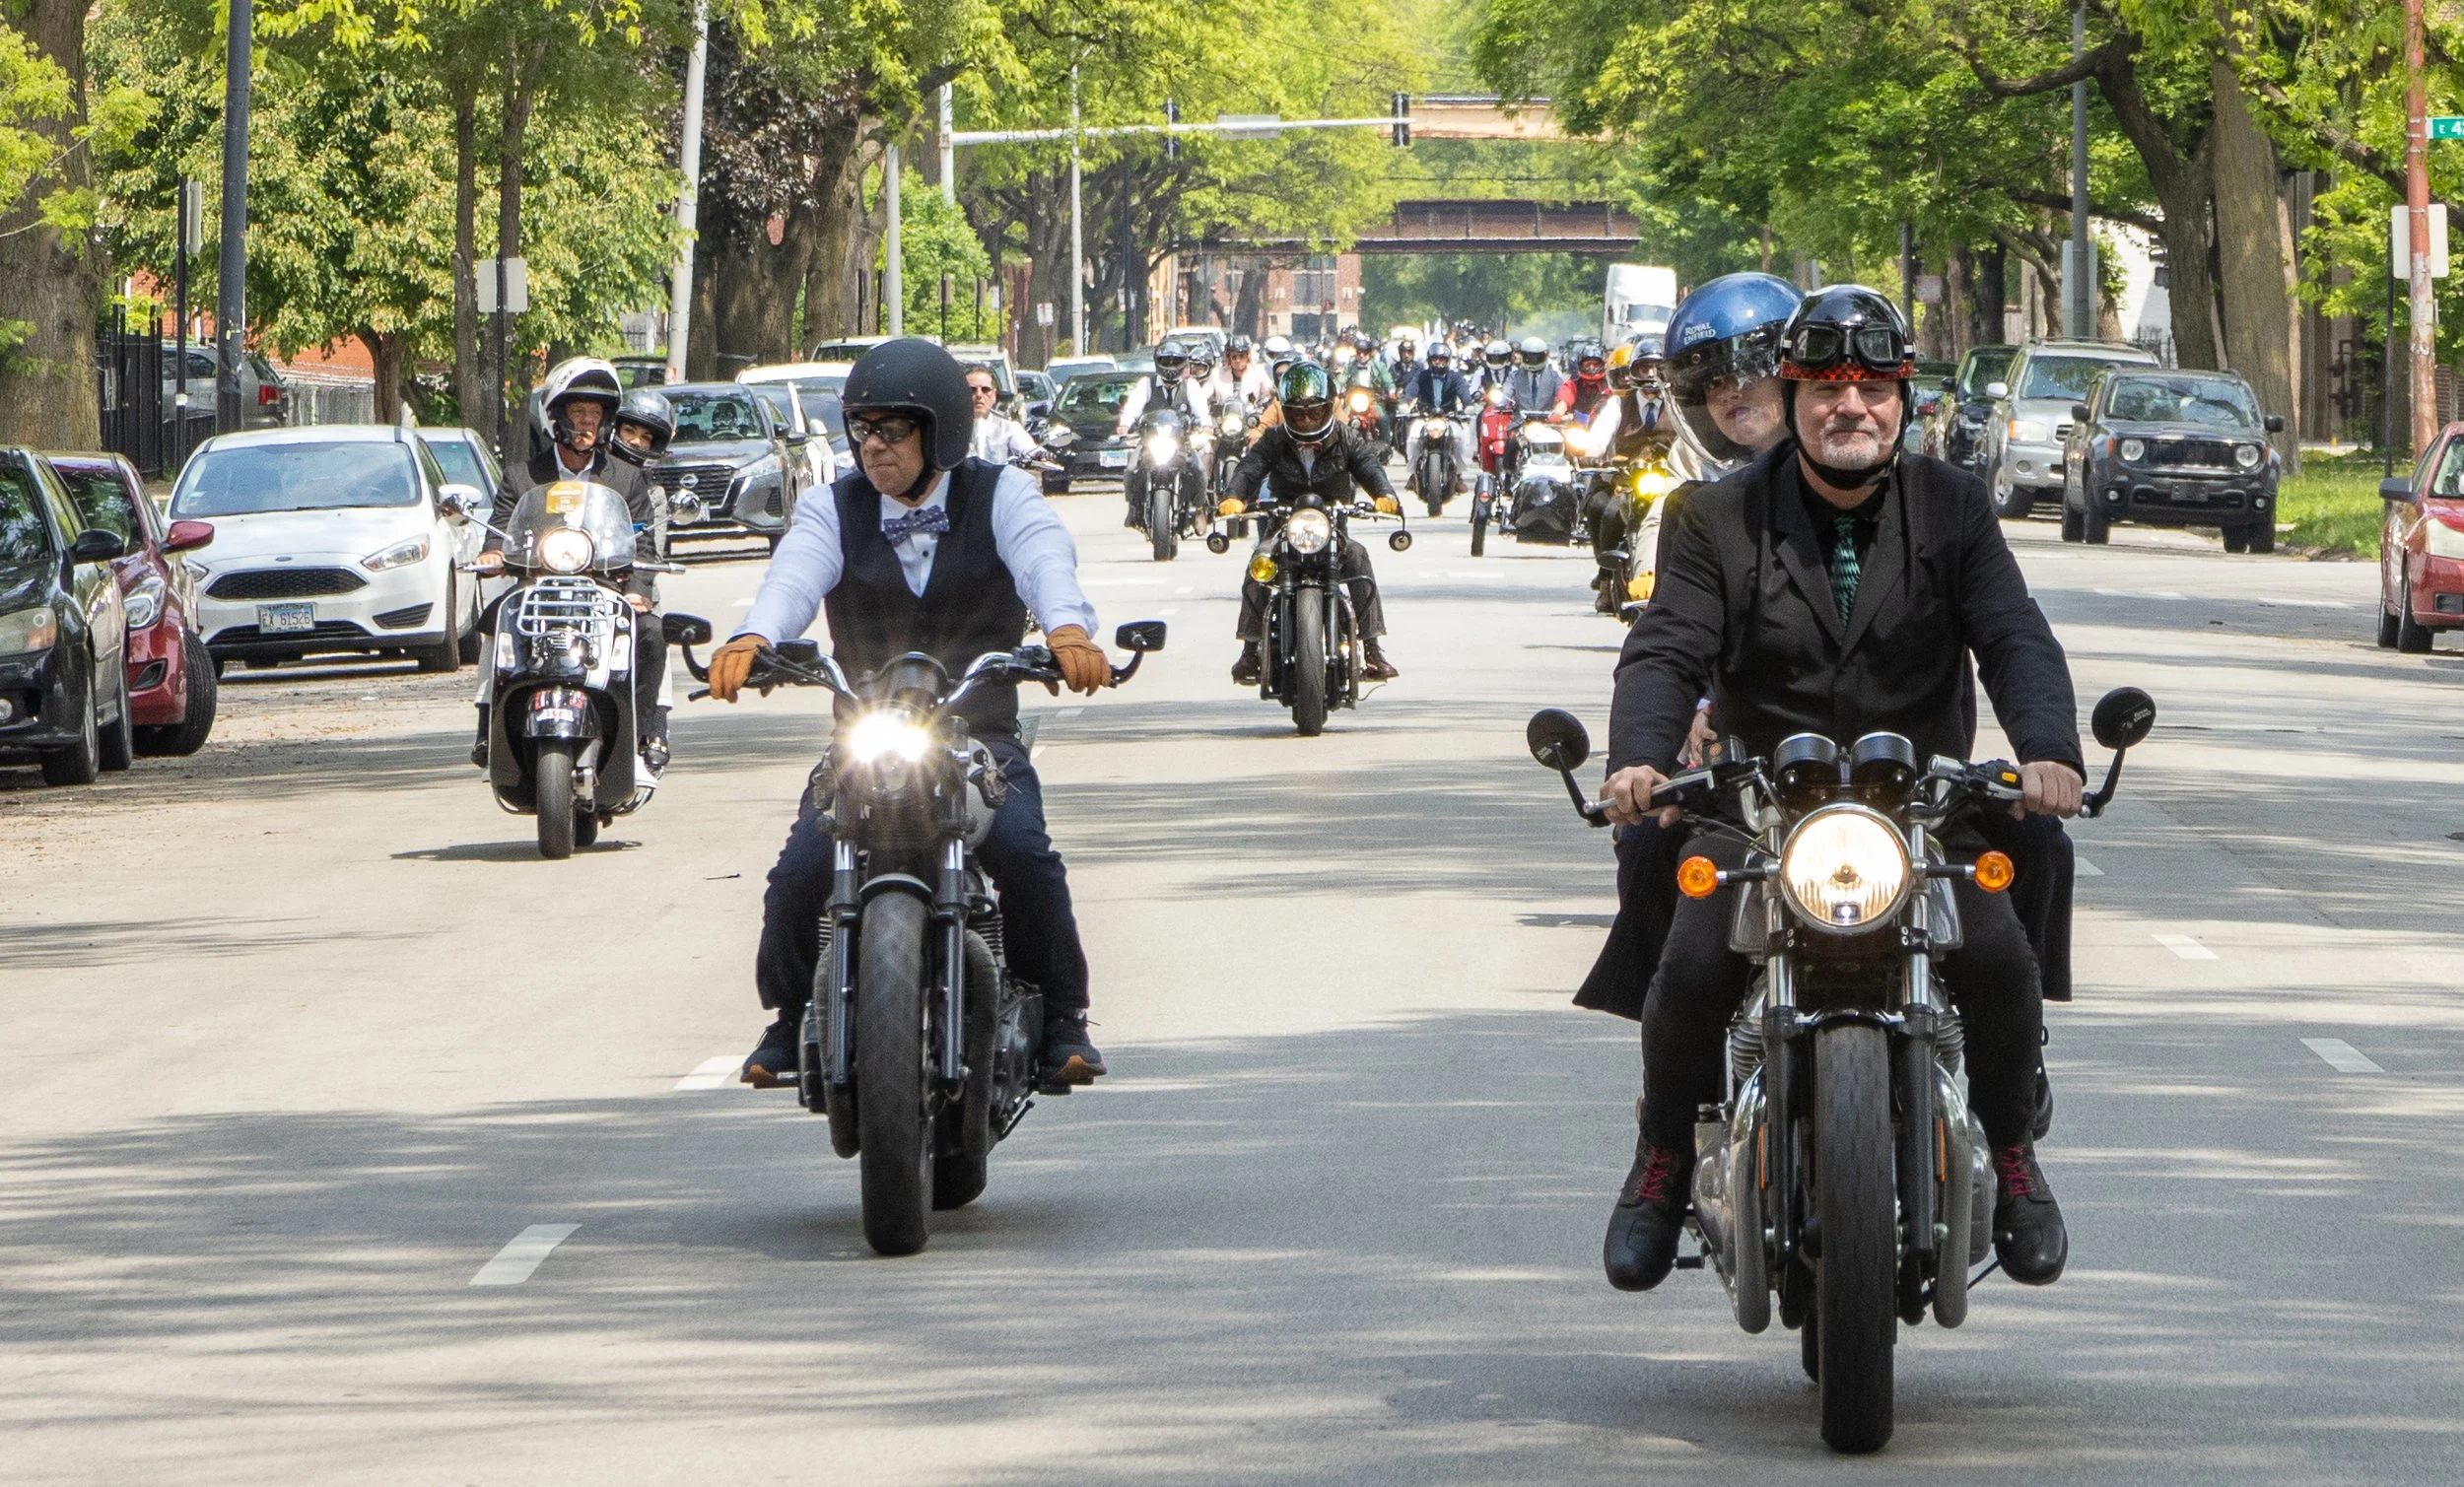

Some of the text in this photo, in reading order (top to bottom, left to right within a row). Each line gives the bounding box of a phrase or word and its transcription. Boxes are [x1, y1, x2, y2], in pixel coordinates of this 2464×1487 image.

[2439, 120, 2464, 136] E 4
[1685, 322, 1711, 335] ROYAL
[1683, 329, 1717, 345] ENFIELD
[280, 611, 310, 626] 61526
